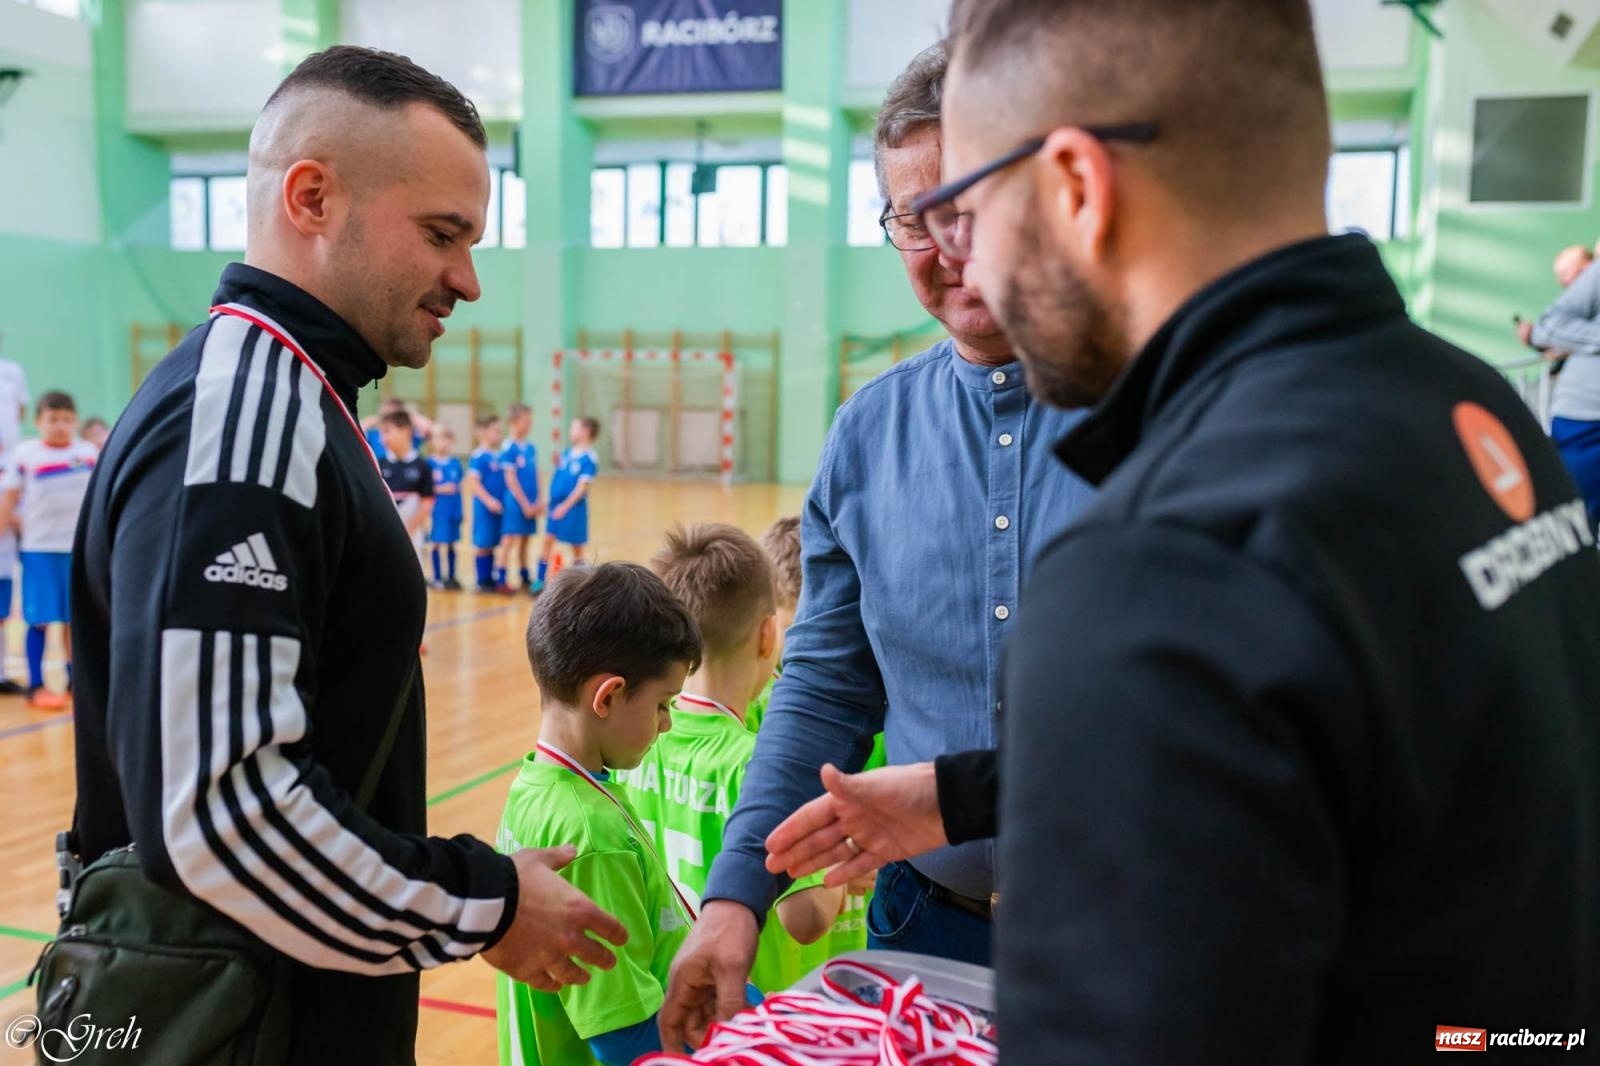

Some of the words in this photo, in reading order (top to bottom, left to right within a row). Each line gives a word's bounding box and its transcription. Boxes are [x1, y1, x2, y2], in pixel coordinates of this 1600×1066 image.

[641, 10, 778, 47] RACIBÓRZ
[204, 563, 288, 592] adidas
[663, 767, 731, 818] TURZA
